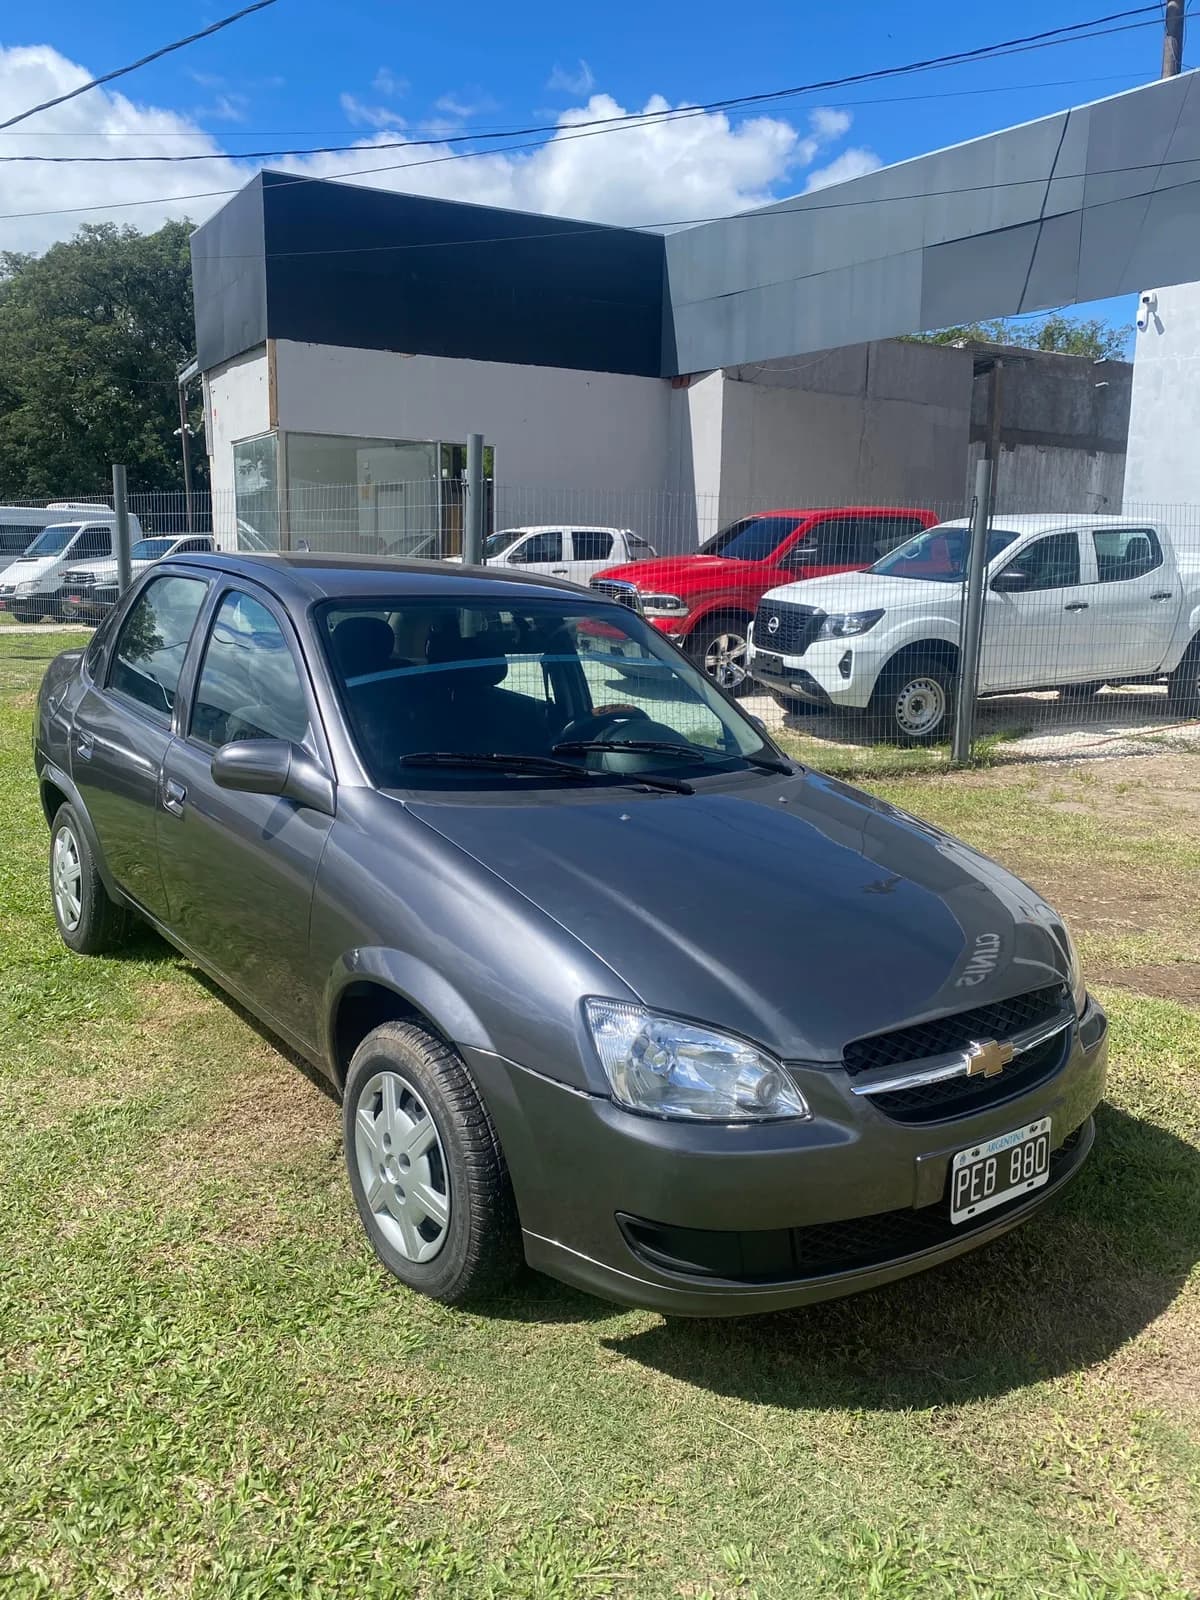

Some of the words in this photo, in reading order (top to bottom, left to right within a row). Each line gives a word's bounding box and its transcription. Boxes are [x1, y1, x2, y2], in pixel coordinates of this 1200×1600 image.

[986, 1131, 1025, 1153] ARGENTINA
[956, 1158, 997, 1209] PEB
[1009, 1136, 1047, 1184] 880
